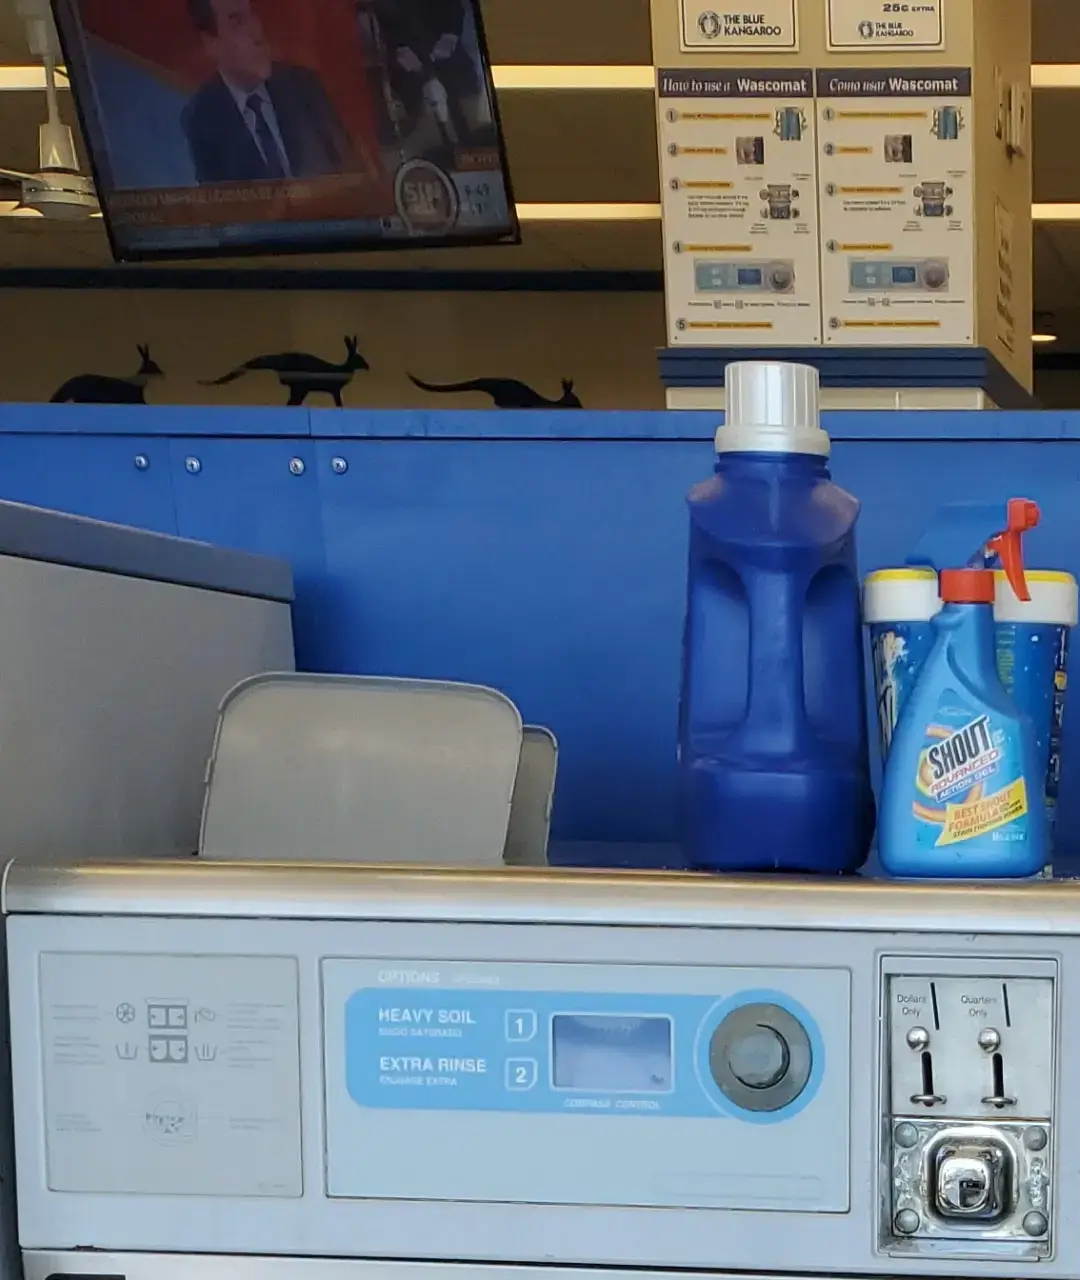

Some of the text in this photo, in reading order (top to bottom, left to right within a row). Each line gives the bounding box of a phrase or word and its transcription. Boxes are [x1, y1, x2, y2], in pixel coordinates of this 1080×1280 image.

[724, 14, 765, 24] THE BLUE
[724, 26, 782, 36] KANGAROO
[875, 29, 914, 37] KANGAROO
[663, 78, 689, 92] How
[691, 79, 702, 92] to
[705, 81, 722, 92] use
[737, 78, 806, 92] Wascomat
[829, 77, 958, 92] Como usar Wascomat
[928, 714, 991, 780] SHOUT
[931, 749, 998, 792] ADVANCED
[940, 765, 996, 798] ACTION GEL
[954, 805, 978, 820] BEST
[980, 789, 1013, 809] SHOUT
[948, 806, 999, 832] FORMULA
[378, 971, 440, 984] OPTIONS
[897, 994, 926, 1003] Dollars
[960, 995, 997, 1004] Quarters
[379, 1008, 476, 1024] HEAVY SOIL
[902, 1007, 921, 1018] Only
[969, 1008, 987, 1018] Only
[514, 1017, 524, 1036] 1
[379, 1056, 487, 1073] EXTRA RINSE
[515, 1066, 528, 1083] 2
[615, 1099, 661, 1110] CONTROL
